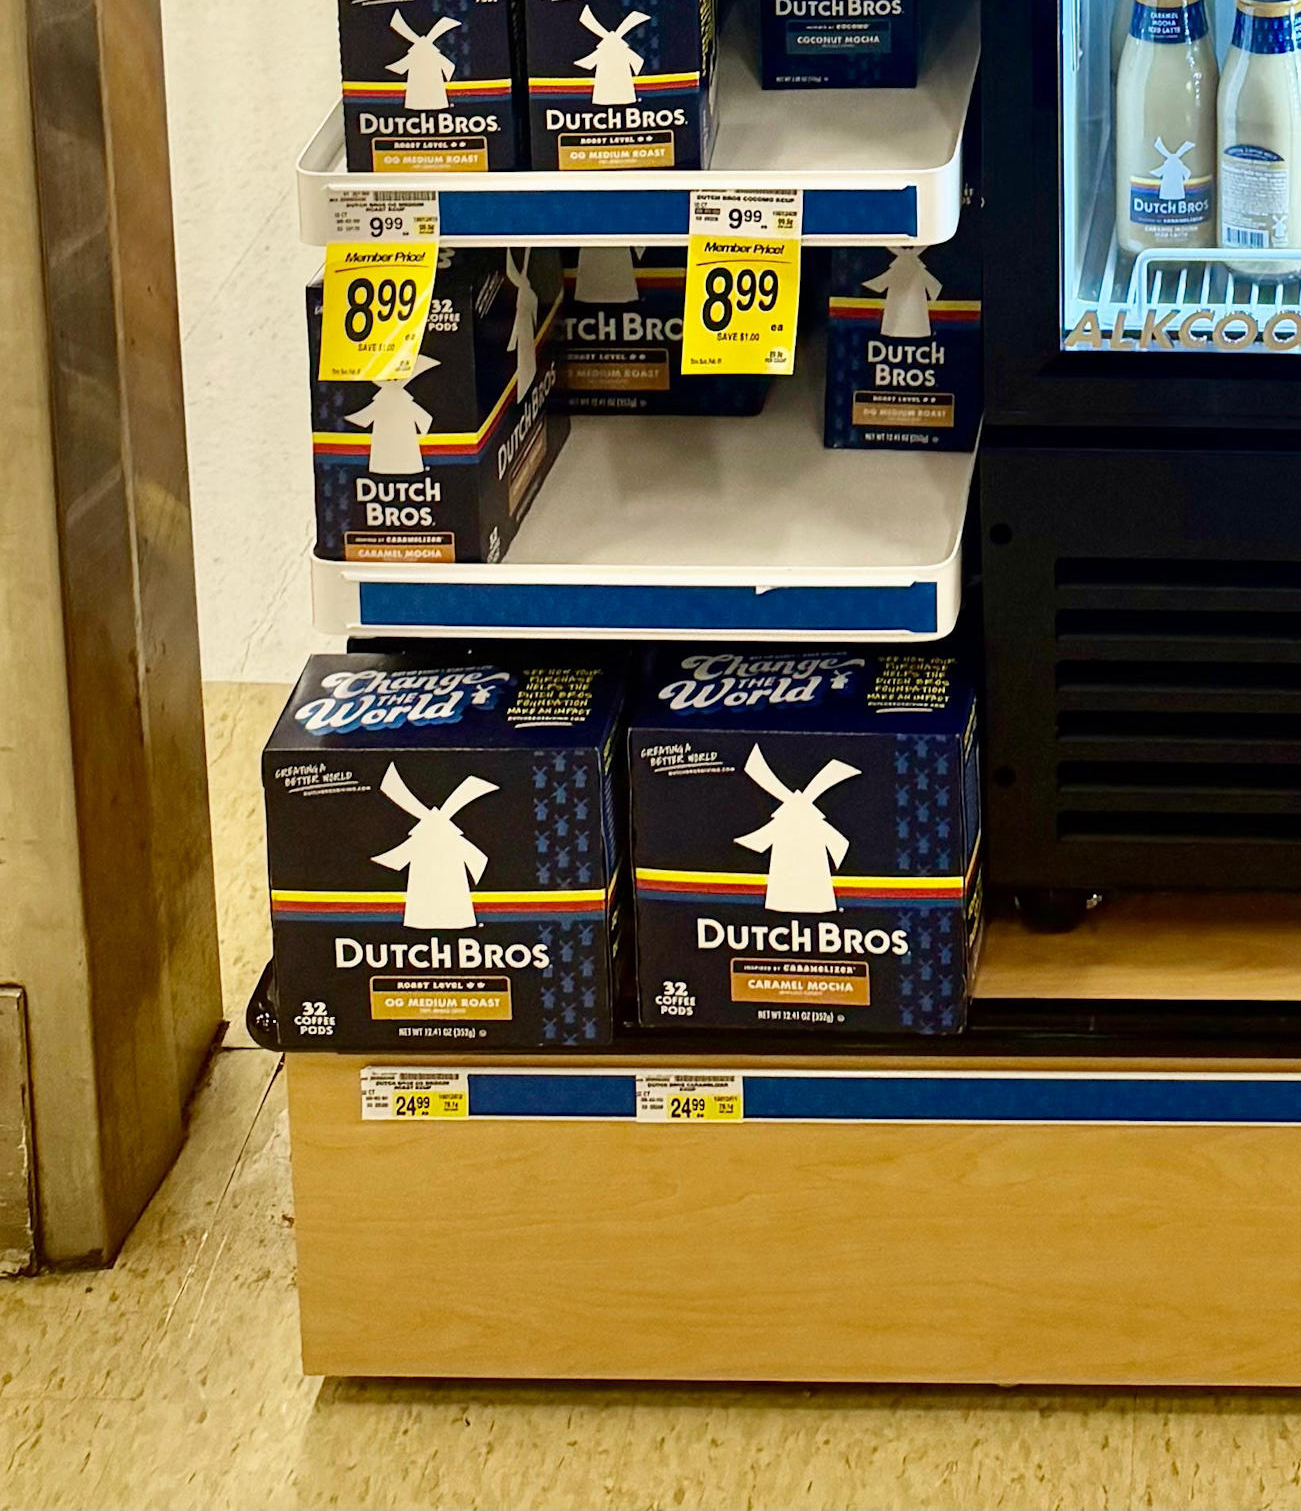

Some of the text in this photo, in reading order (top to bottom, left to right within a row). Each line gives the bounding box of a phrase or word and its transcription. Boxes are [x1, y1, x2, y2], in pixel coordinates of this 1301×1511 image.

[322, 671, 509, 698] Change
[294, 692, 464, 731] World
[377, 692, 416, 706] THE
